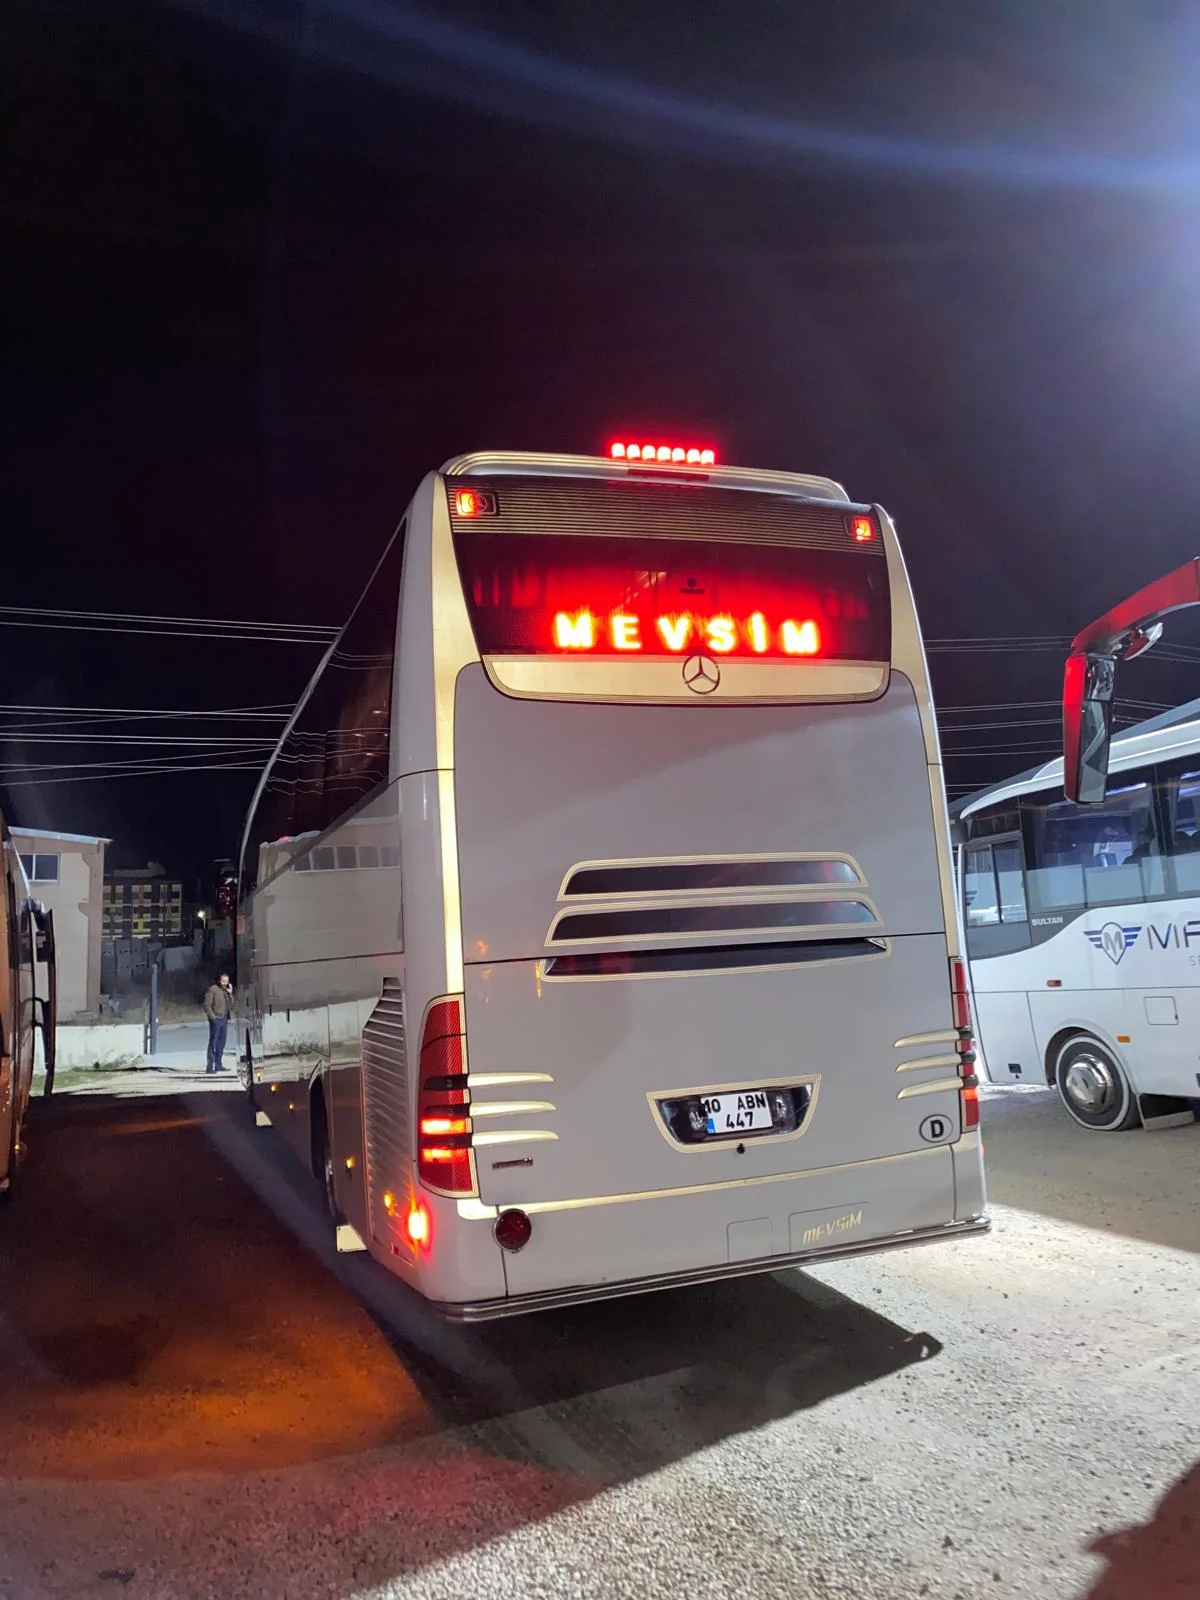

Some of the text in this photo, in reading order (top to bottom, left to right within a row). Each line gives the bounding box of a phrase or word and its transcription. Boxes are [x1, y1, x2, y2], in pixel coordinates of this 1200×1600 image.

[1032, 916, 1064, 926] SULTAN
[704, 1093, 766, 1114] 10 ABN
[726, 1111, 753, 1129] 447
[930, 1119, 944, 1138] D
